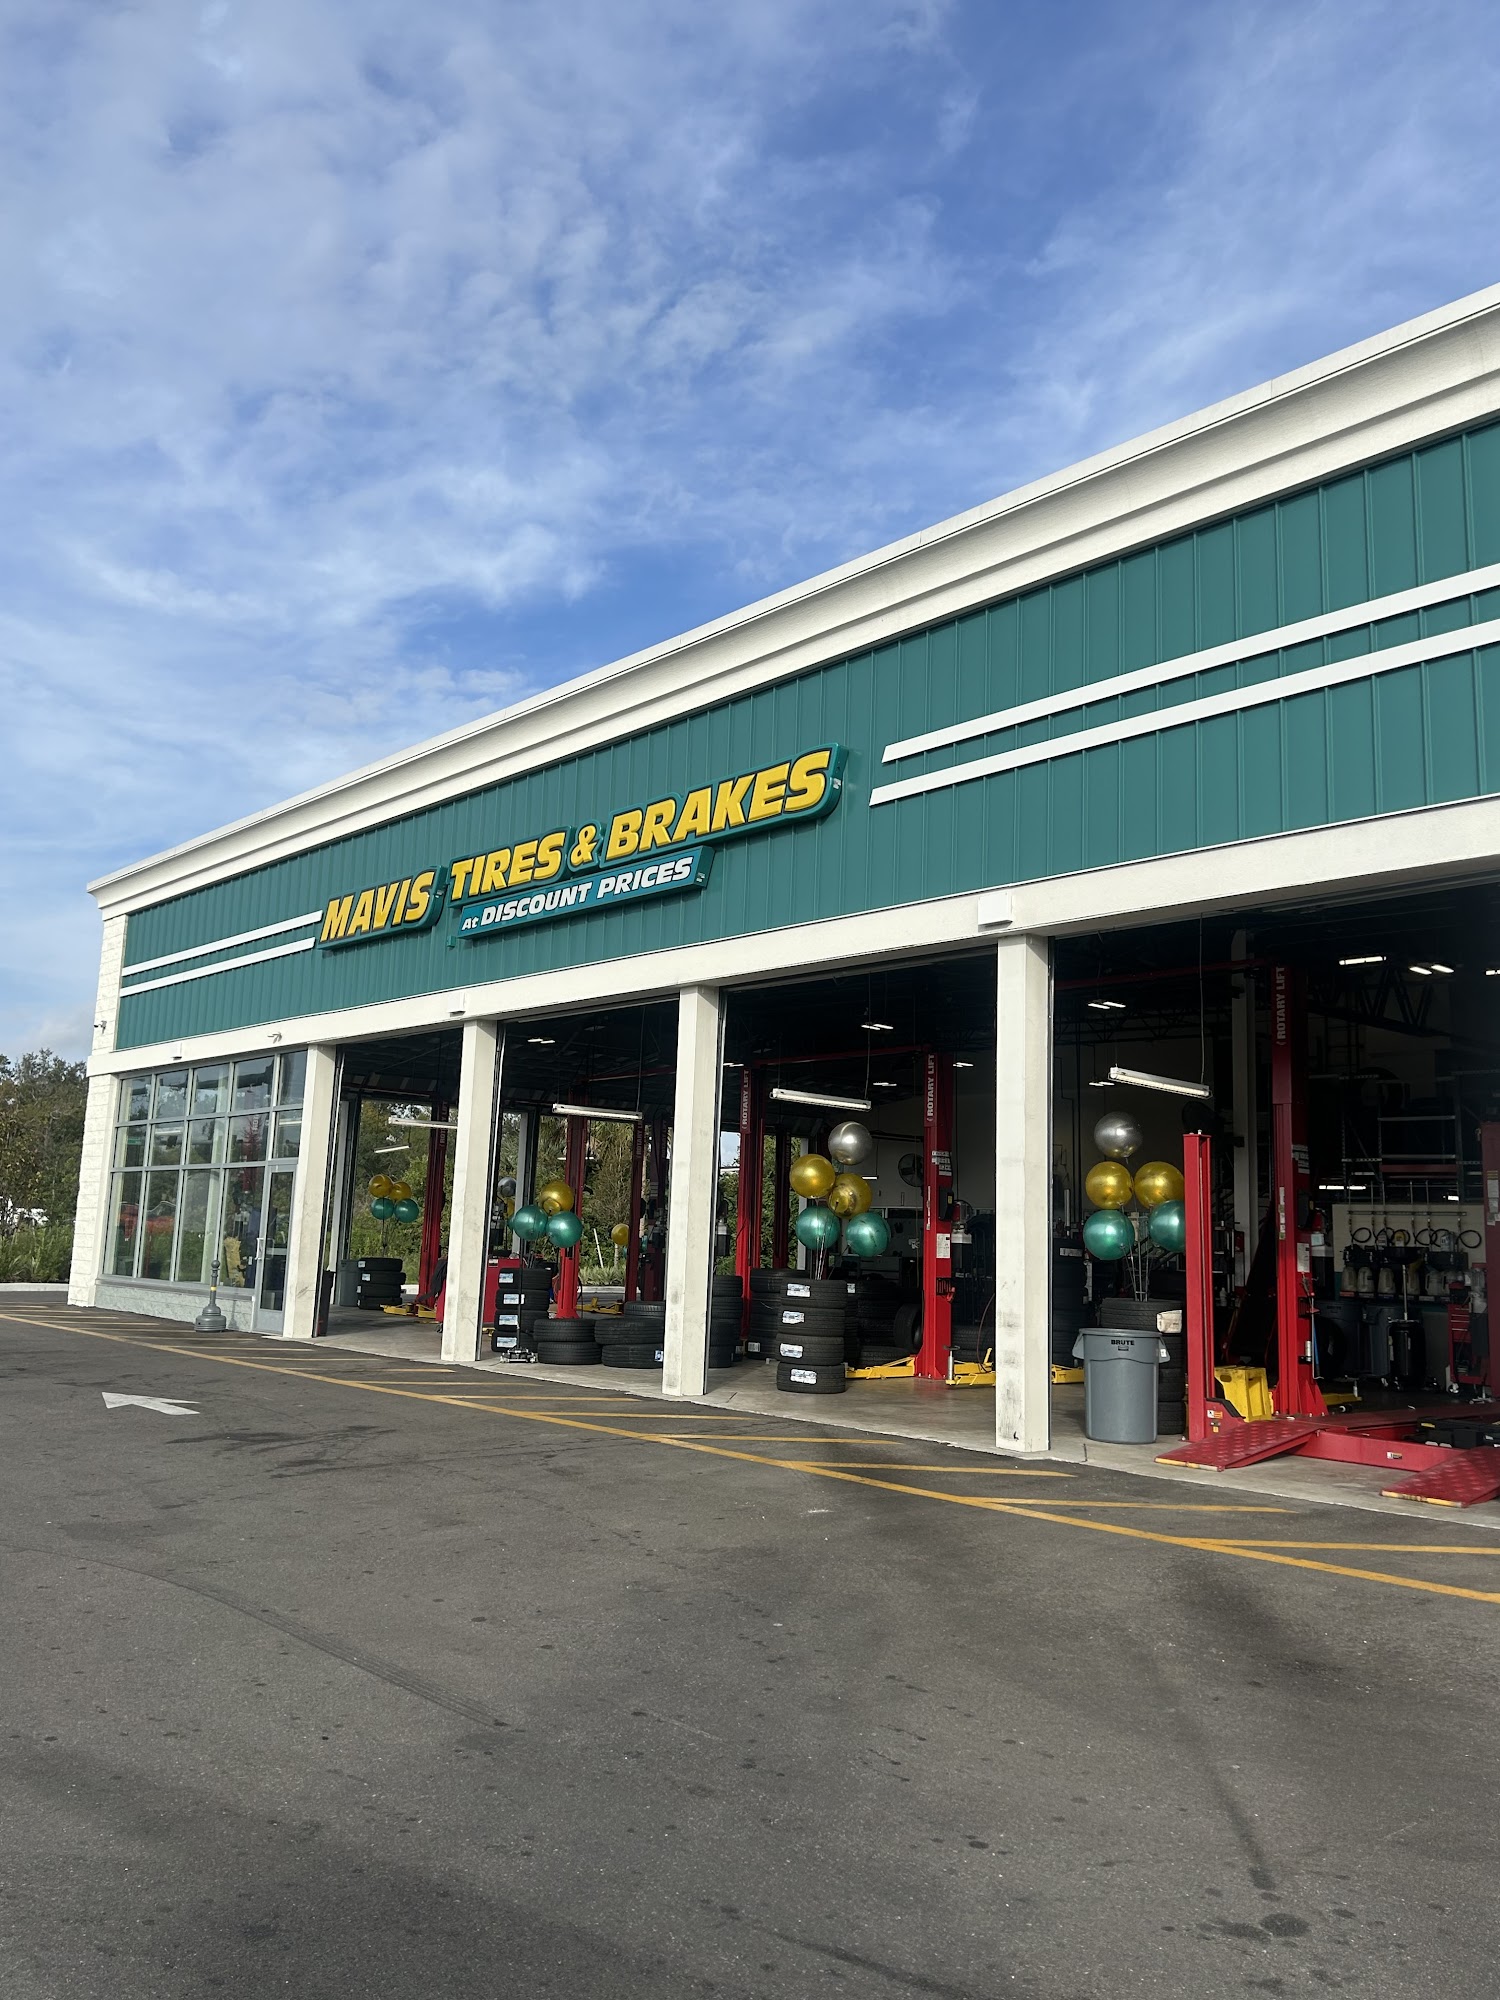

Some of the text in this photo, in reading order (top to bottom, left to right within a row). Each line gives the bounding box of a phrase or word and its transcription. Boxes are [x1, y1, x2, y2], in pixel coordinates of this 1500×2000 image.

[319, 750, 831, 942] MAVIS TIRES & BRAKES
[461, 856, 694, 931] At DISCOUNT PRICES
[1276, 967, 1286, 1040] ROTARY LIFT
[927, 1053, 935, 1075] LIFT
